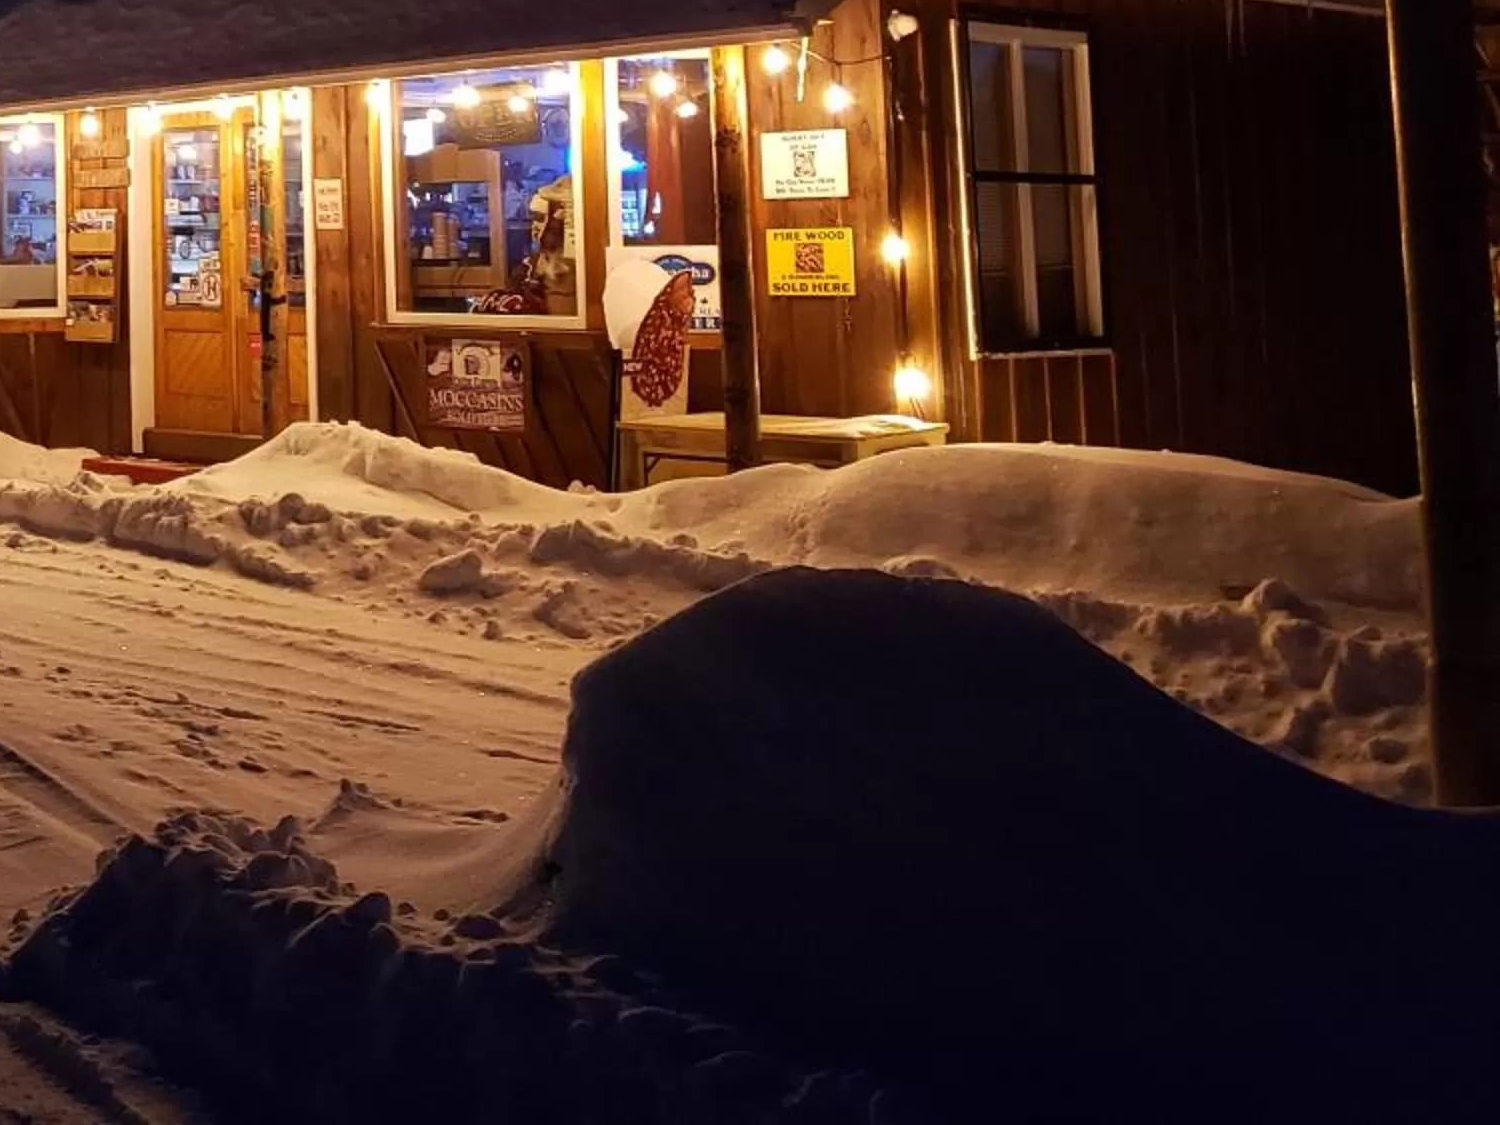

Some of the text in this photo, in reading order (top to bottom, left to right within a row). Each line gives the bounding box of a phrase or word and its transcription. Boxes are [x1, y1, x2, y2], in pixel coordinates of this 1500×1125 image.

[773, 230, 845, 242] FIRE WOOD
[772, 281, 851, 293] SOLD HERE
[428, 388, 525, 413] MOCCASINS
